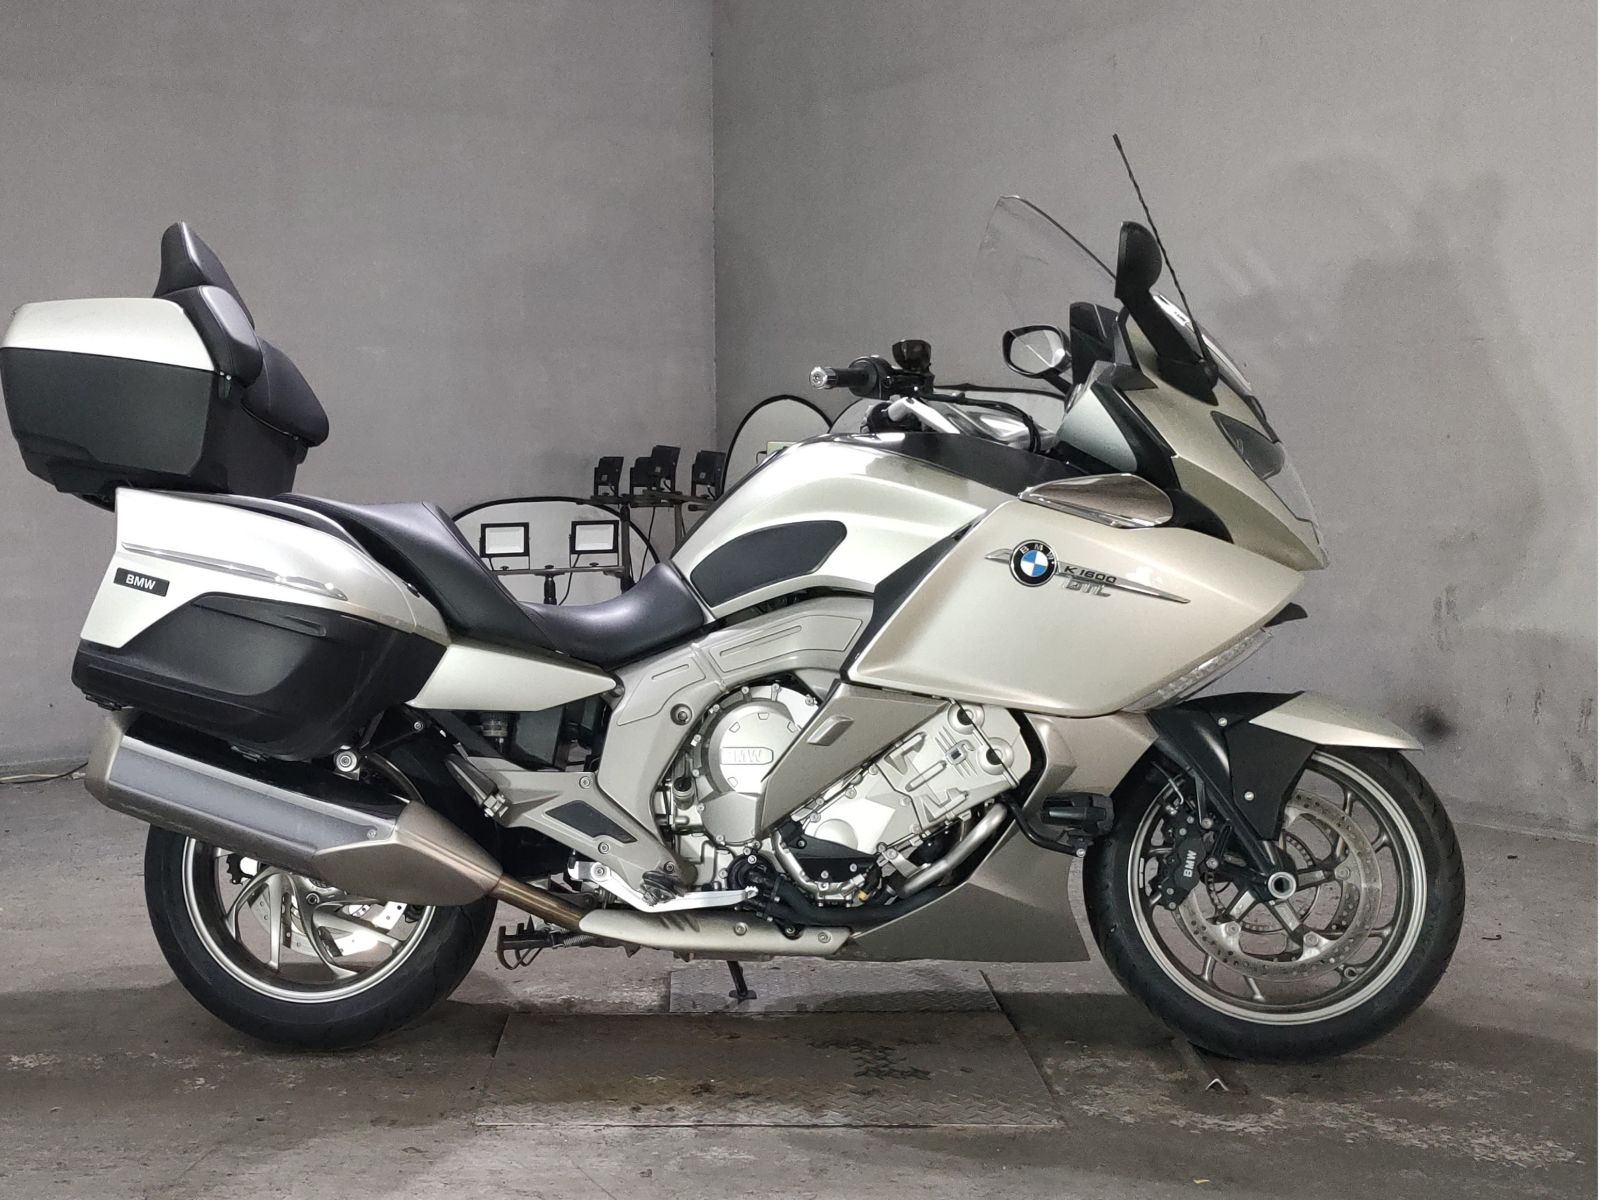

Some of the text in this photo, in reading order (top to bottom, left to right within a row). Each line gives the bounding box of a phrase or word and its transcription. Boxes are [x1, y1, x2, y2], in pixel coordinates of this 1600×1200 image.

[1019, 543, 1055, 561] BMW
[125, 573, 156, 590] BMW
[1063, 565, 1117, 584] K 1600
[1183, 849, 1197, 878] BMW
